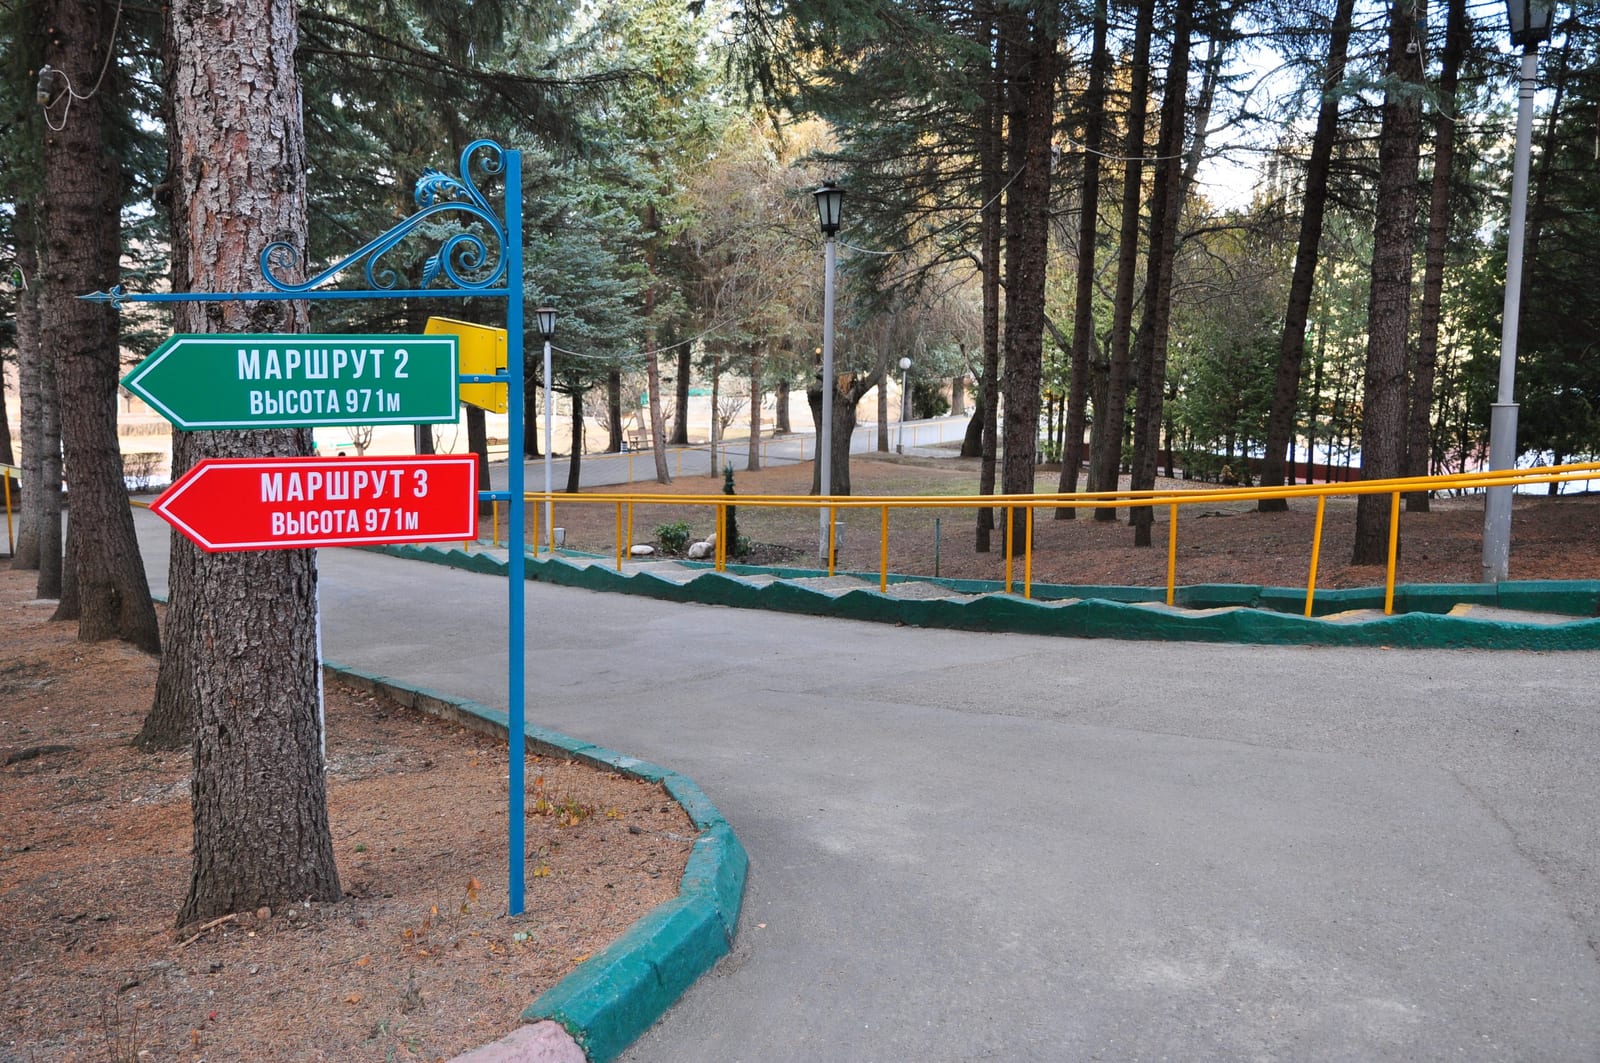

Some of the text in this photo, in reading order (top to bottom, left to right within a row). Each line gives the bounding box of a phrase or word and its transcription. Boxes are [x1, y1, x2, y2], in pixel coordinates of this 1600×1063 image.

[238, 349, 409, 380] МАРШРУТ 2
[250, 389, 340, 415] ВЫСОТА
[261, 469, 428, 503] МАРШРУТ 3
[271, 509, 360, 536] ВЫСОТА
